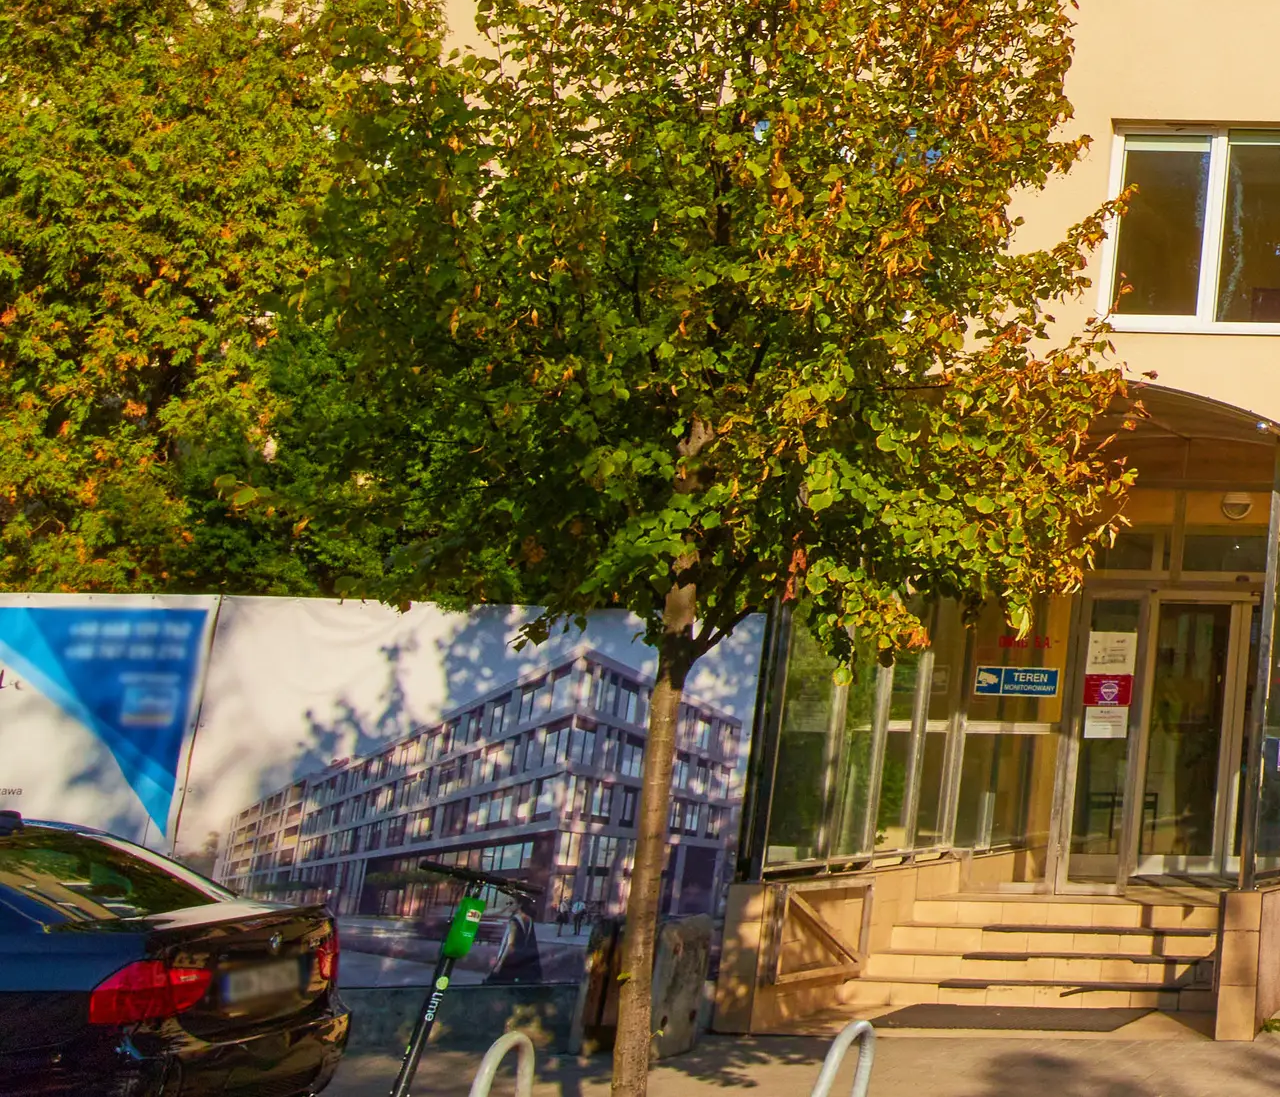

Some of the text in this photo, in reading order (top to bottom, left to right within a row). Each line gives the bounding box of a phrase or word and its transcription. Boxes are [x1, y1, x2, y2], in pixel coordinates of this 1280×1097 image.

[1013, 672, 1048, 683] TEREN
[1004, 684, 1055, 692] MONITOROWANY
[425, 992, 444, 1022] Lime
